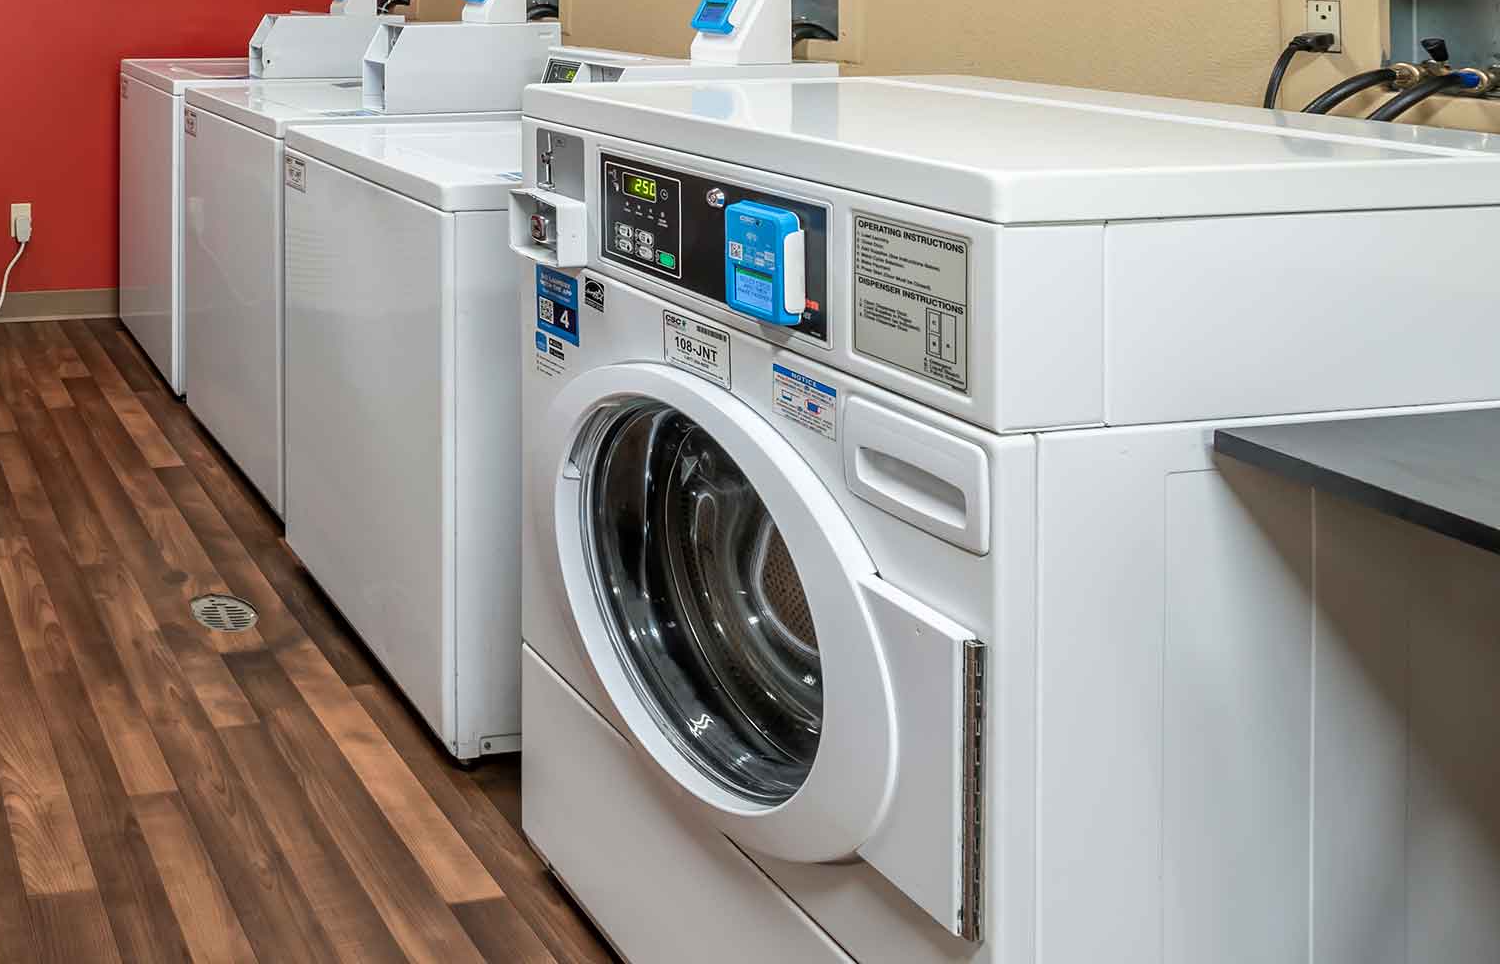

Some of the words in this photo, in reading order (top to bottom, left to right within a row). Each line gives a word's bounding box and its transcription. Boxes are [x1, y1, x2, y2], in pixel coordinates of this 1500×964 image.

[858, 219, 901, 237] OPERATING
[903, 230, 964, 254] INSTRUCTIONS
[858, 276, 901, 295] DISPENSER
[902, 291, 964, 315] INSTRUCTIONS
[559, 310, 570, 329] 4
[675, 336, 718, 362] 108-JNT
[791, 371, 817, 388] NOTICE
